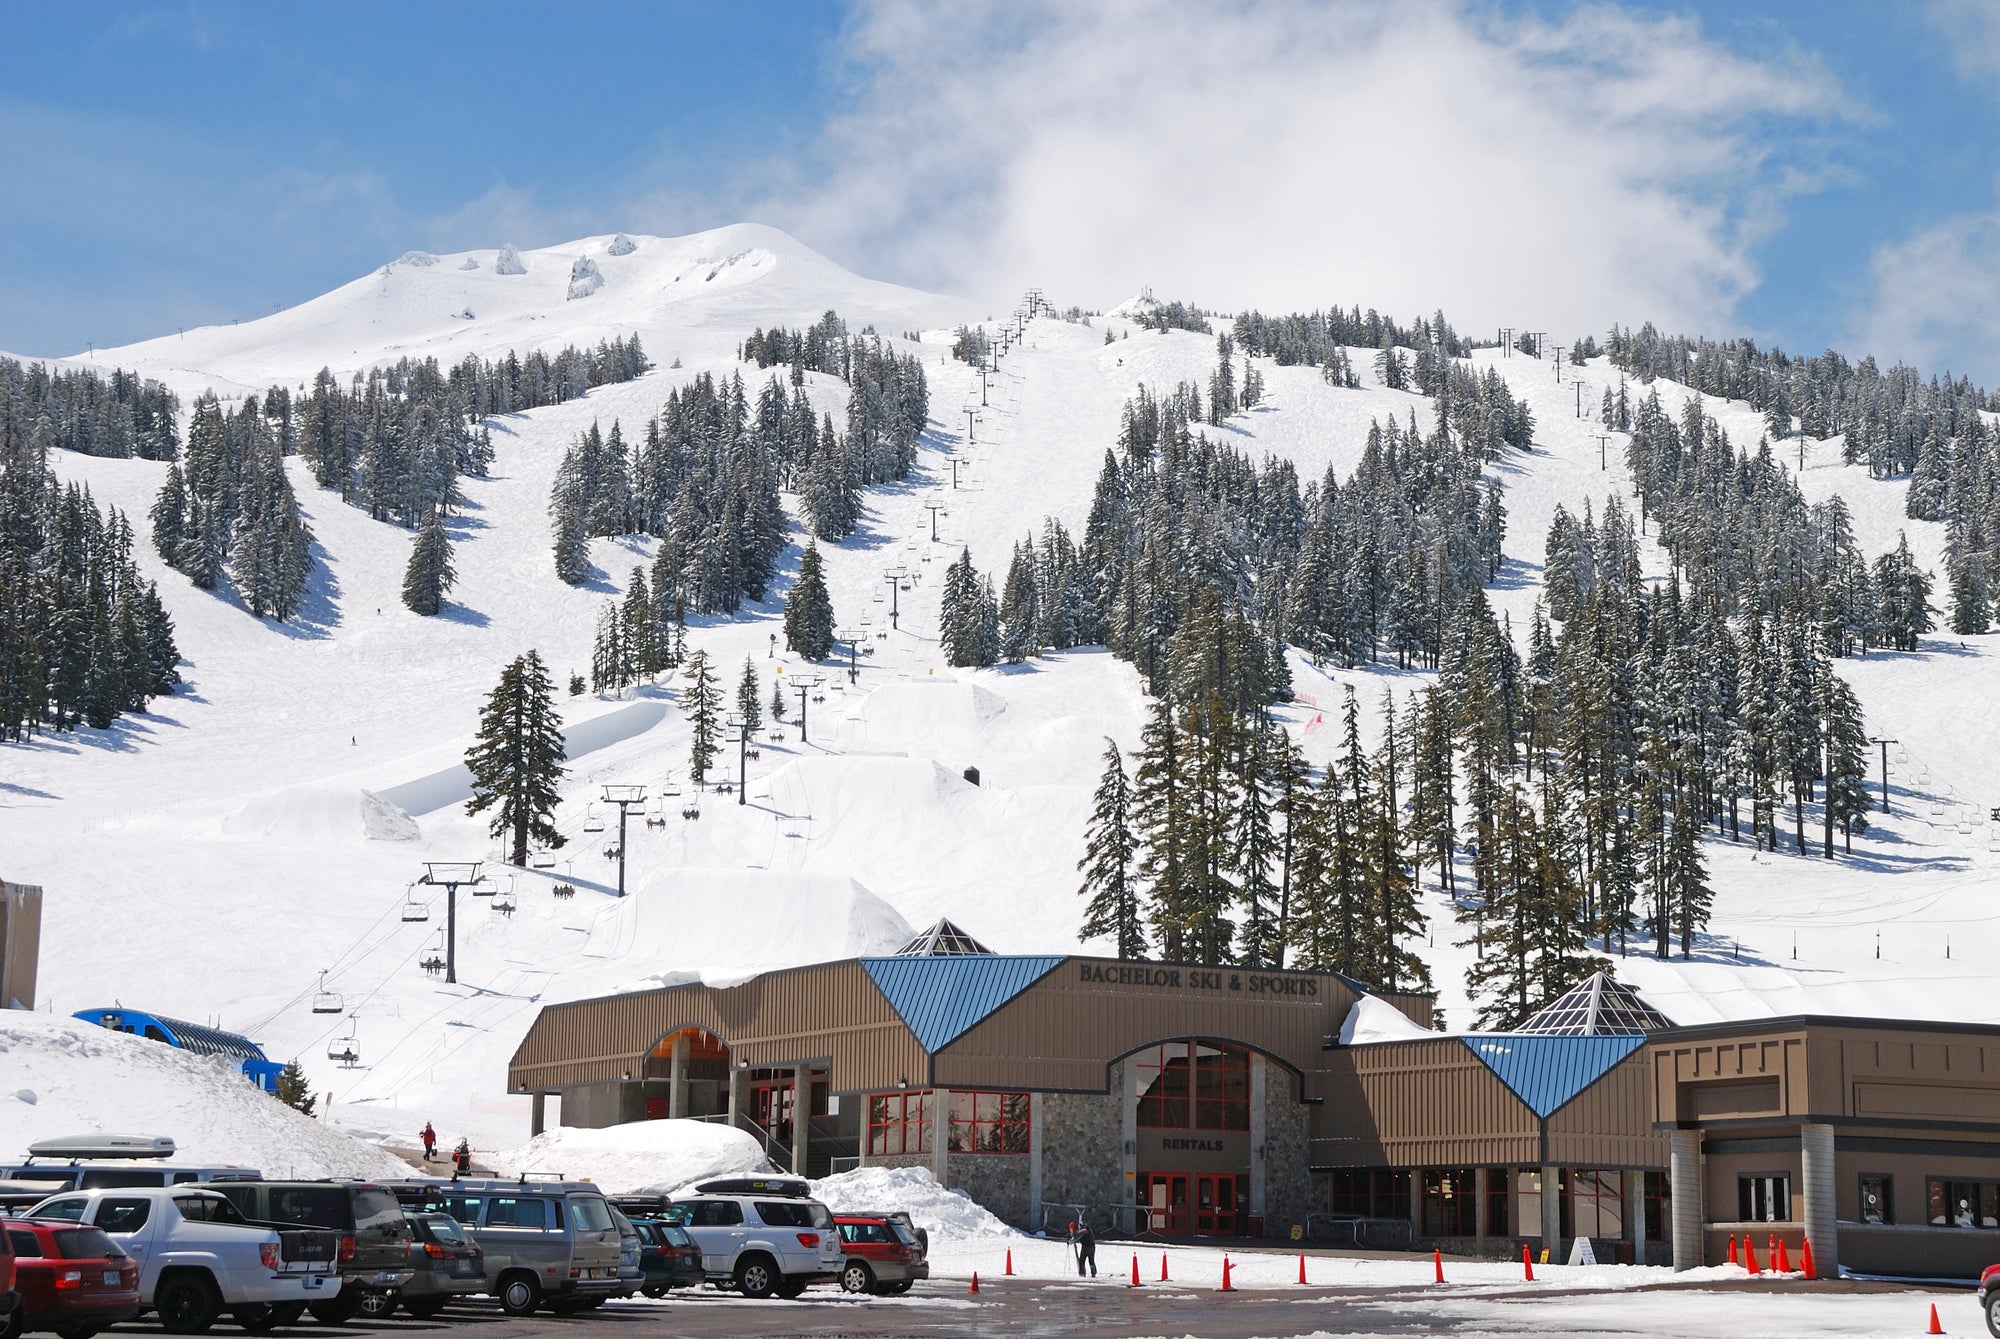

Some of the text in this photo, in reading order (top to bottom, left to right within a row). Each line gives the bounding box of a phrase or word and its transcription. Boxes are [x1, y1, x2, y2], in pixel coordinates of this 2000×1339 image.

[1080, 964, 1317, 996] BACHELOR SKI & SPORTS
[1162, 1138, 1223, 1152] RENTALS
